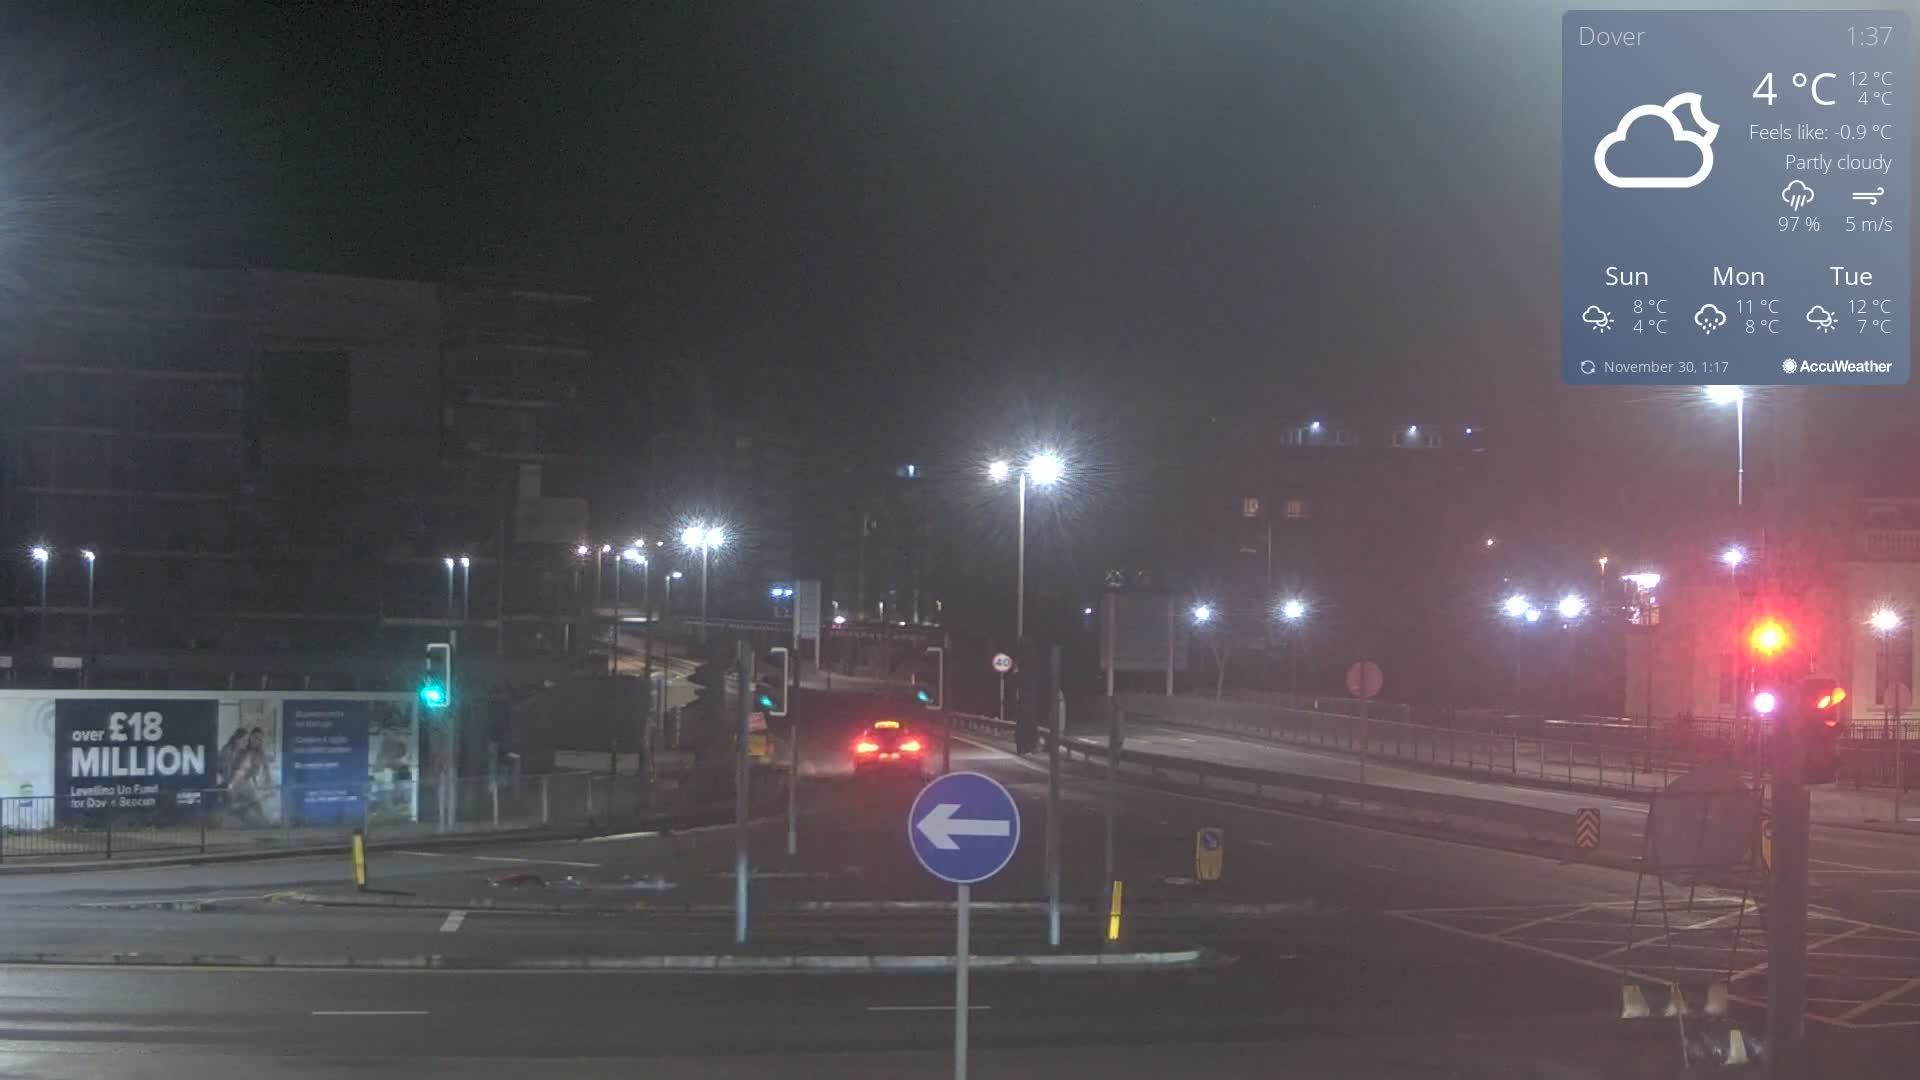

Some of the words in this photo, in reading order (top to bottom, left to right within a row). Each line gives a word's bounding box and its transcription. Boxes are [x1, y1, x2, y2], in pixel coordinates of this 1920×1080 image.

[996, 658, 1009, 667] 40
[72, 730, 104, 742] over
[109, 711, 163, 742] £18
[71, 744, 205, 777] MILLION
